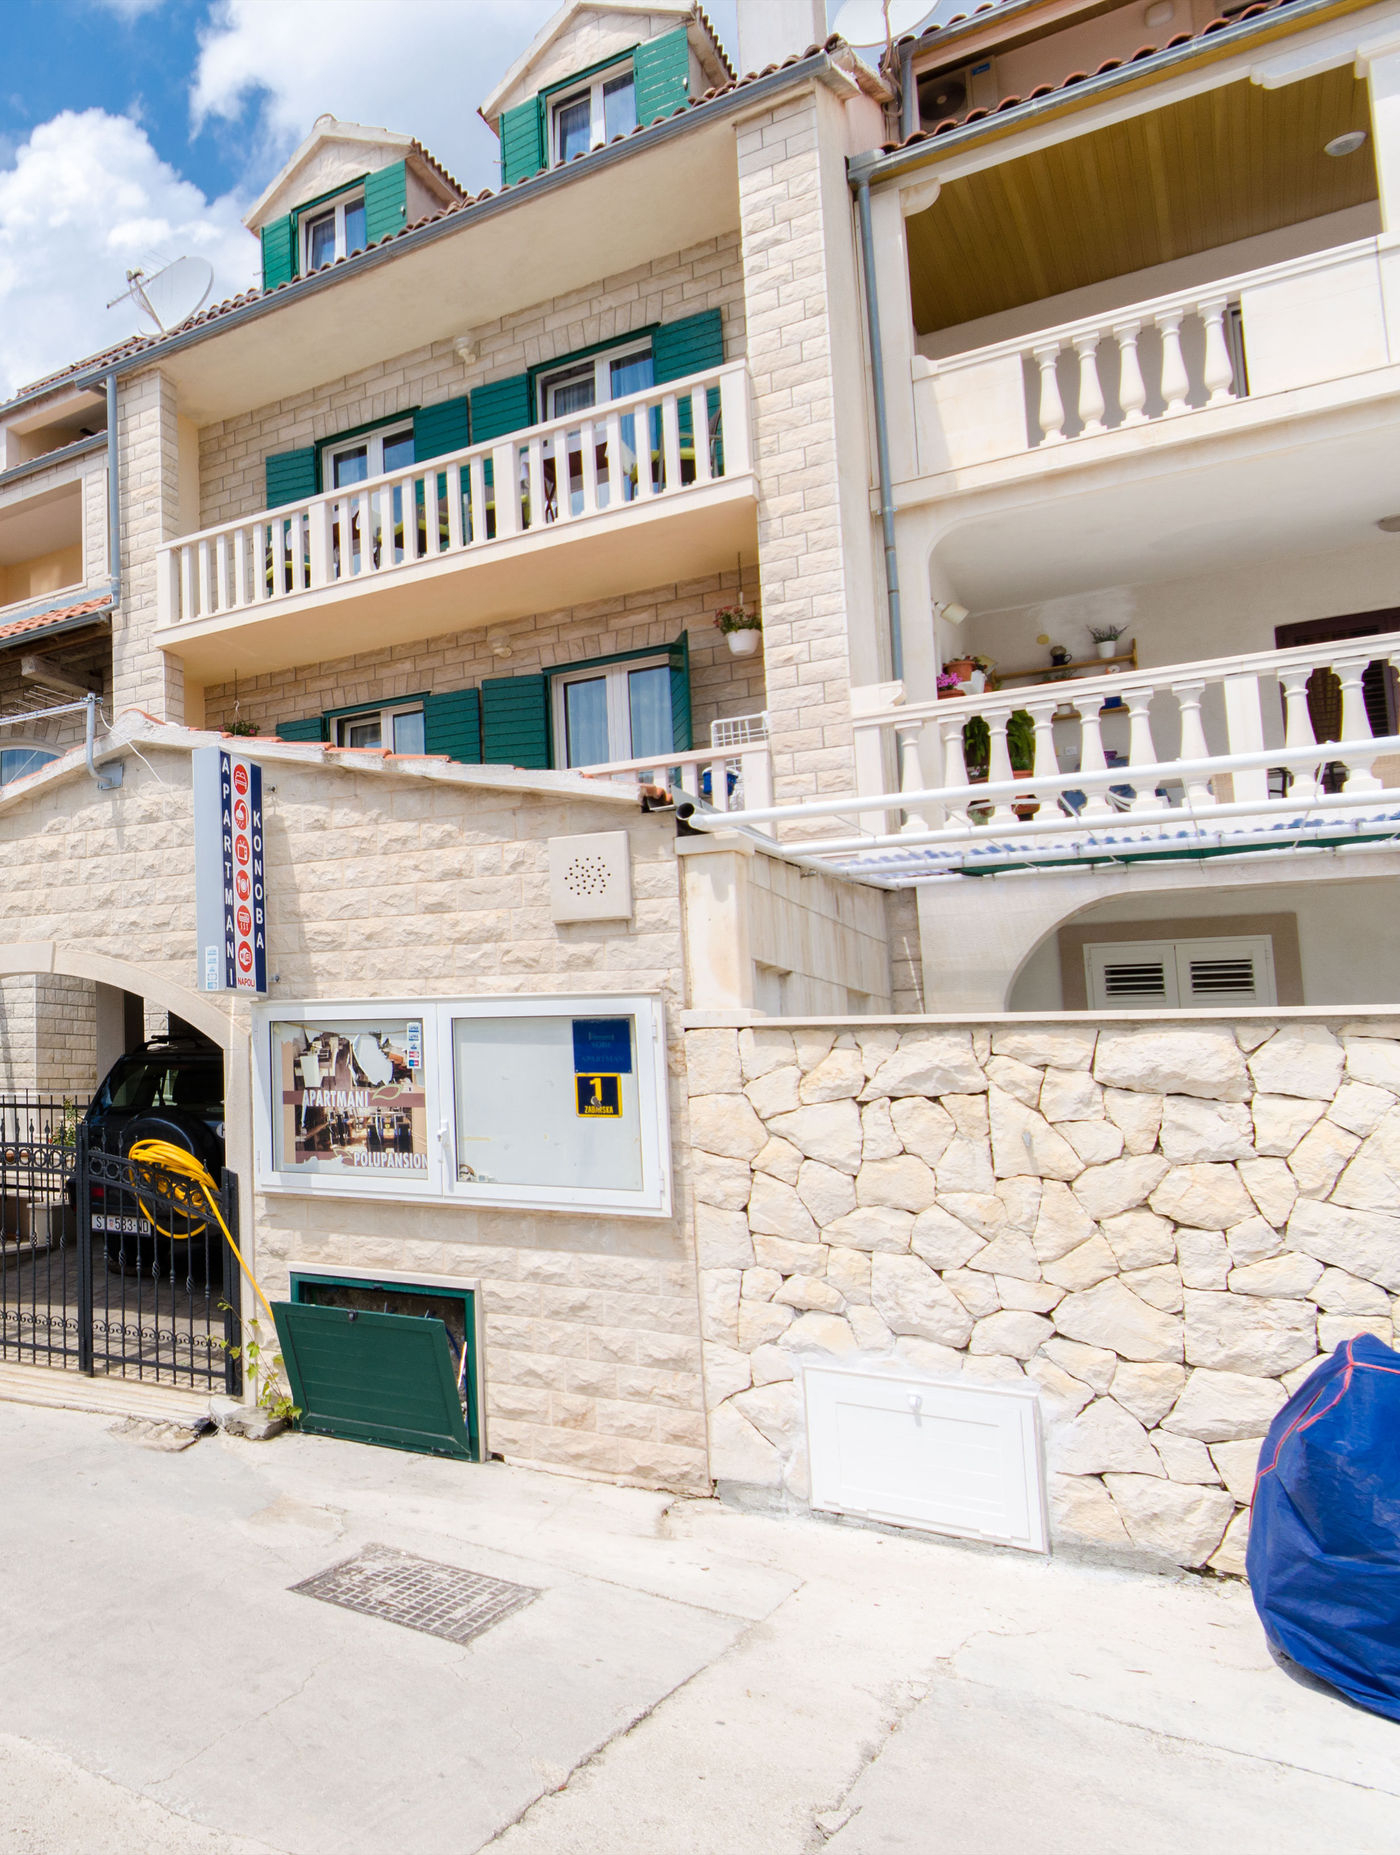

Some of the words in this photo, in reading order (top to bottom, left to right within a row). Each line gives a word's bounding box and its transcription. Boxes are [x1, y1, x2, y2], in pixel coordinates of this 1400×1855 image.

[221, 756, 235, 986] APARTMANI
[253, 810, 265, 949] KONOBA
[238, 977, 255, 987] NAPOLI
[302, 1089, 369, 1108] APARTMANI
[589, 1077, 603, 1102] 1
[353, 1151, 428, 1169] POLUPANSION
